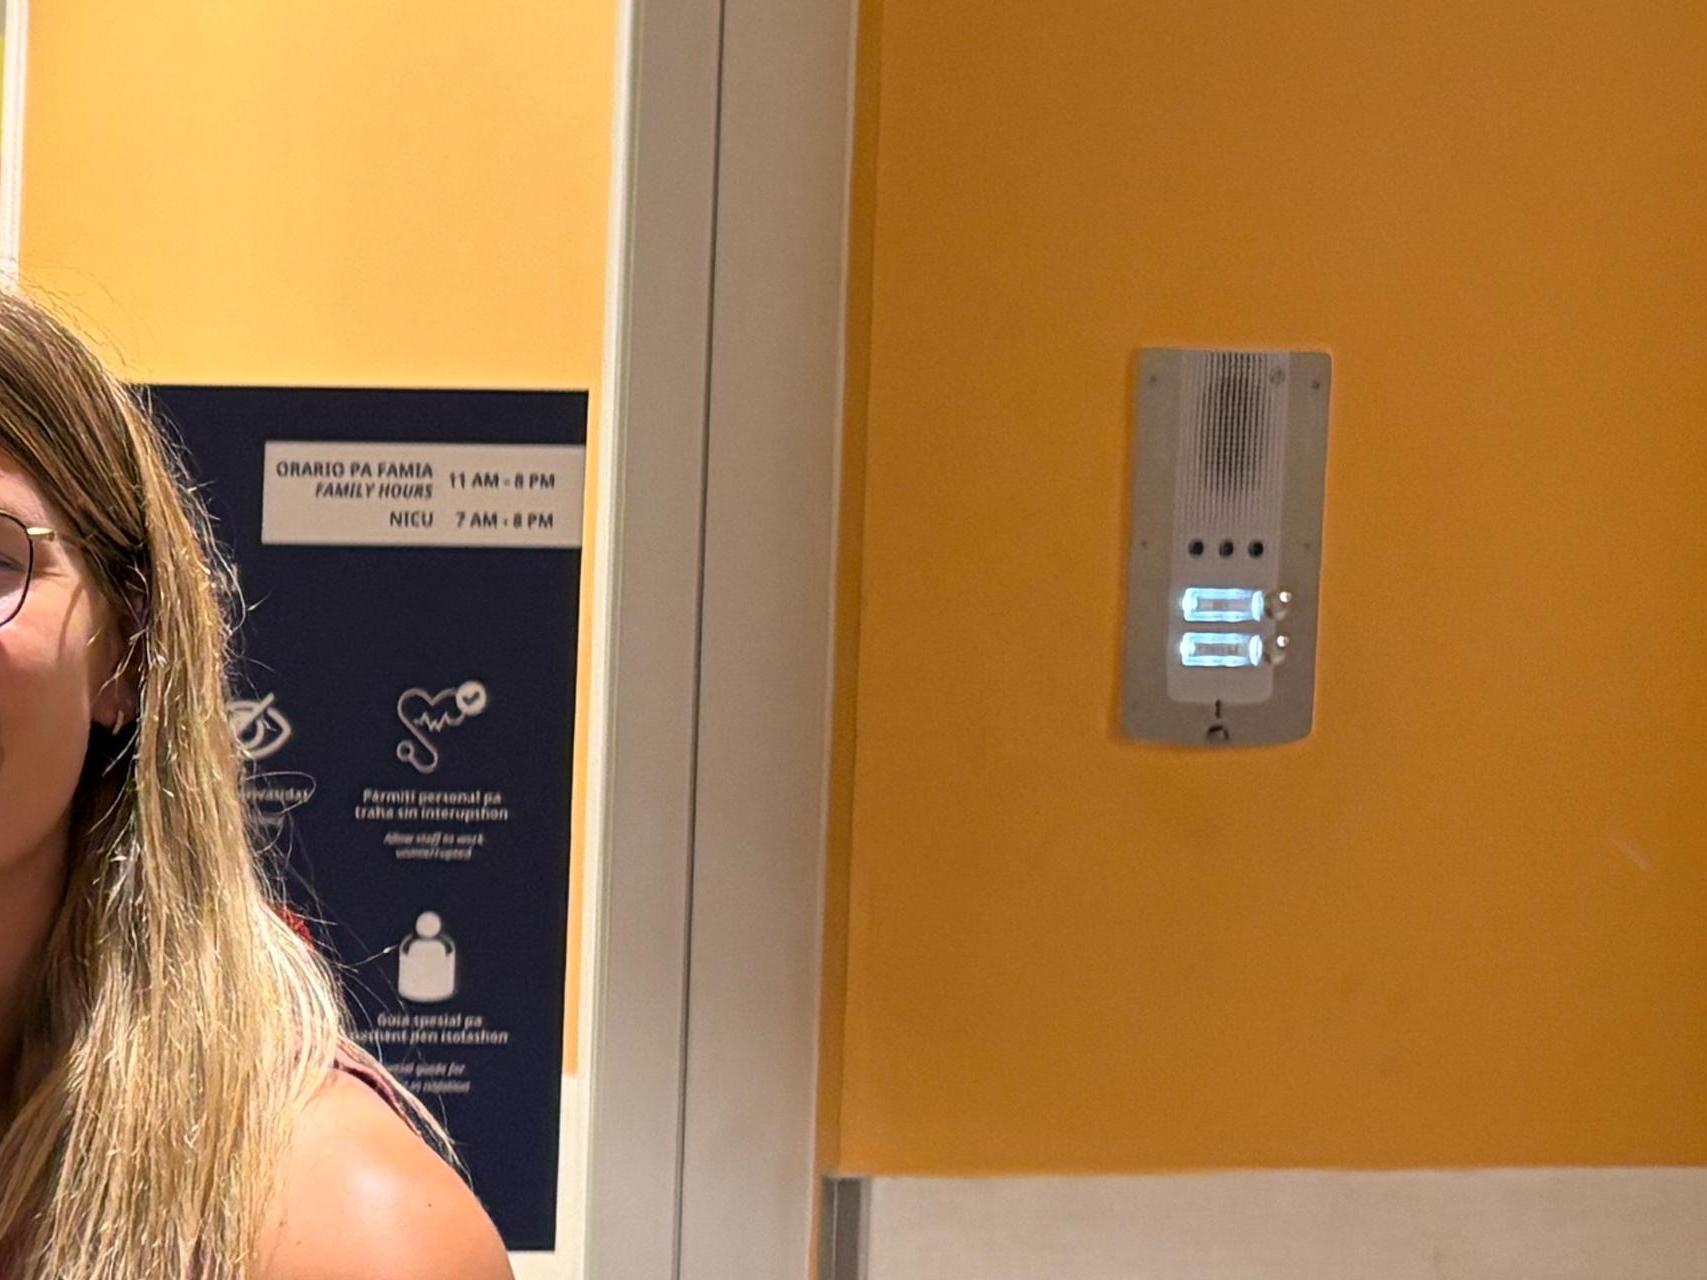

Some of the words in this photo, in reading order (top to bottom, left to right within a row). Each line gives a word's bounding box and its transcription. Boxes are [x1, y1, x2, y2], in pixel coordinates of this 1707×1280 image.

[276, 461, 345, 478] ORARIO
[350, 462, 372, 478] PA
[377, 462, 434, 479] FAMIA
[450, 473, 466, 488] 11
[471, 473, 499, 488] AM
[529, 473, 555, 489] PM
[315, 482, 376, 498] FAMILY
[378, 482, 434, 499] HOURS
[389, 510, 434, 528] NICU
[455, 511, 465, 528] 7
[470, 512, 498, 528] AM
[527, 512, 554, 529] PM
